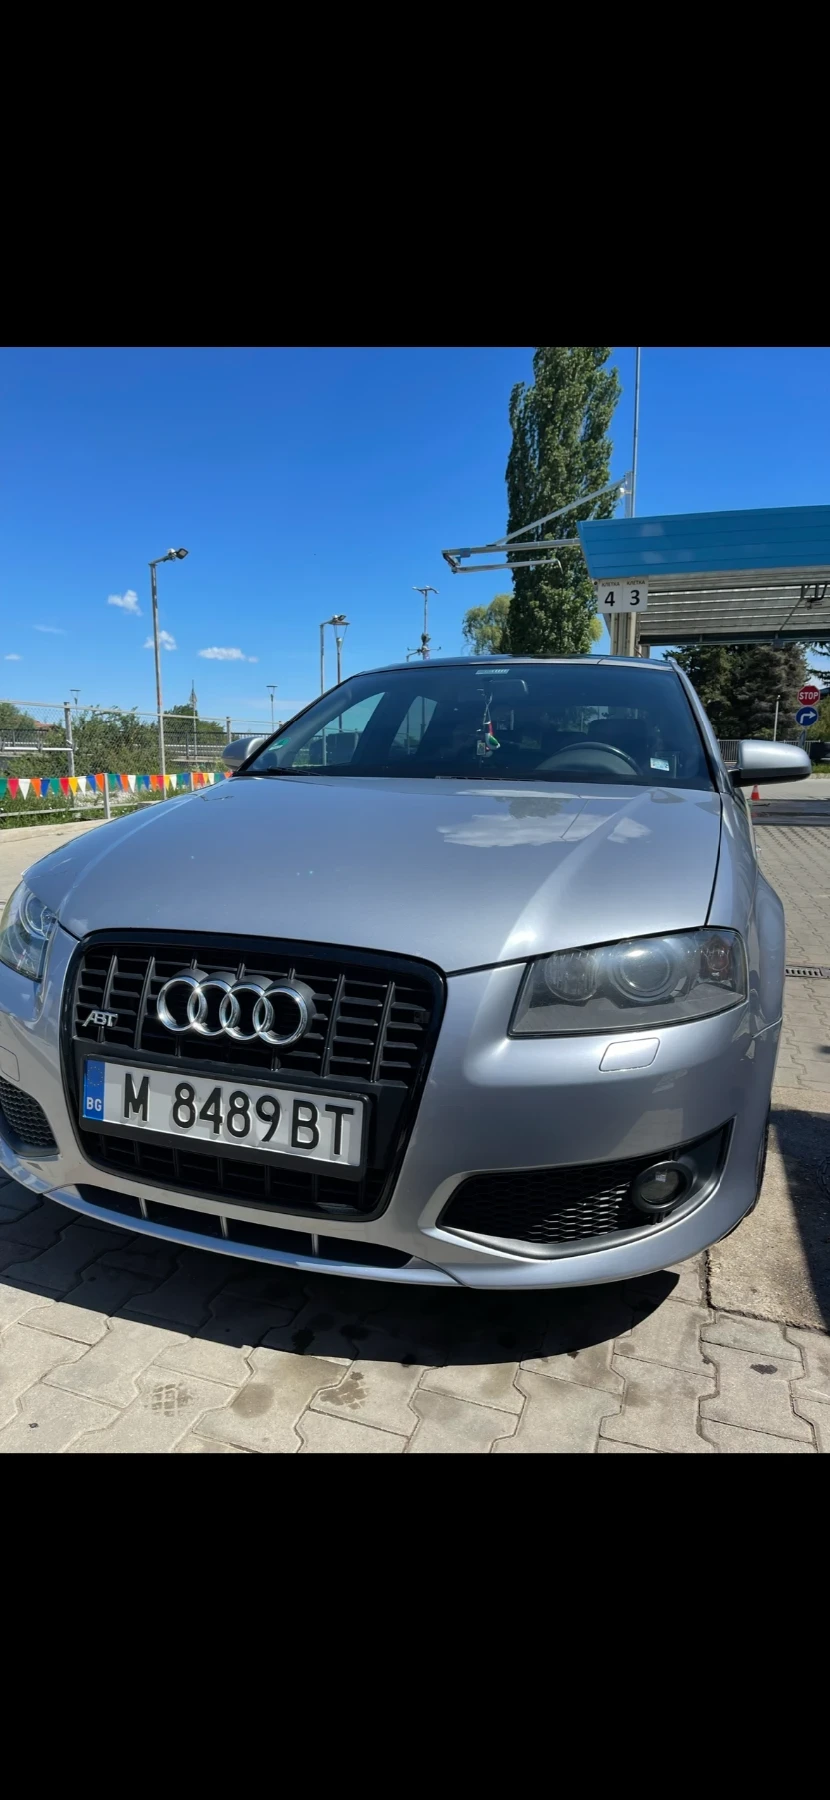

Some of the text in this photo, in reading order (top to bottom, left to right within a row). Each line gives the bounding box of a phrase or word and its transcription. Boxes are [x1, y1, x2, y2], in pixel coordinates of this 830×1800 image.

[604, 591, 616, 607] 4
[629, 589, 641, 606] 3
[799, 691, 819, 700] STOP
[81, 1010, 118, 1027] ABT
[86, 1096, 103, 1112] BG
[123, 1072, 355, 1156] M 8489 BT
